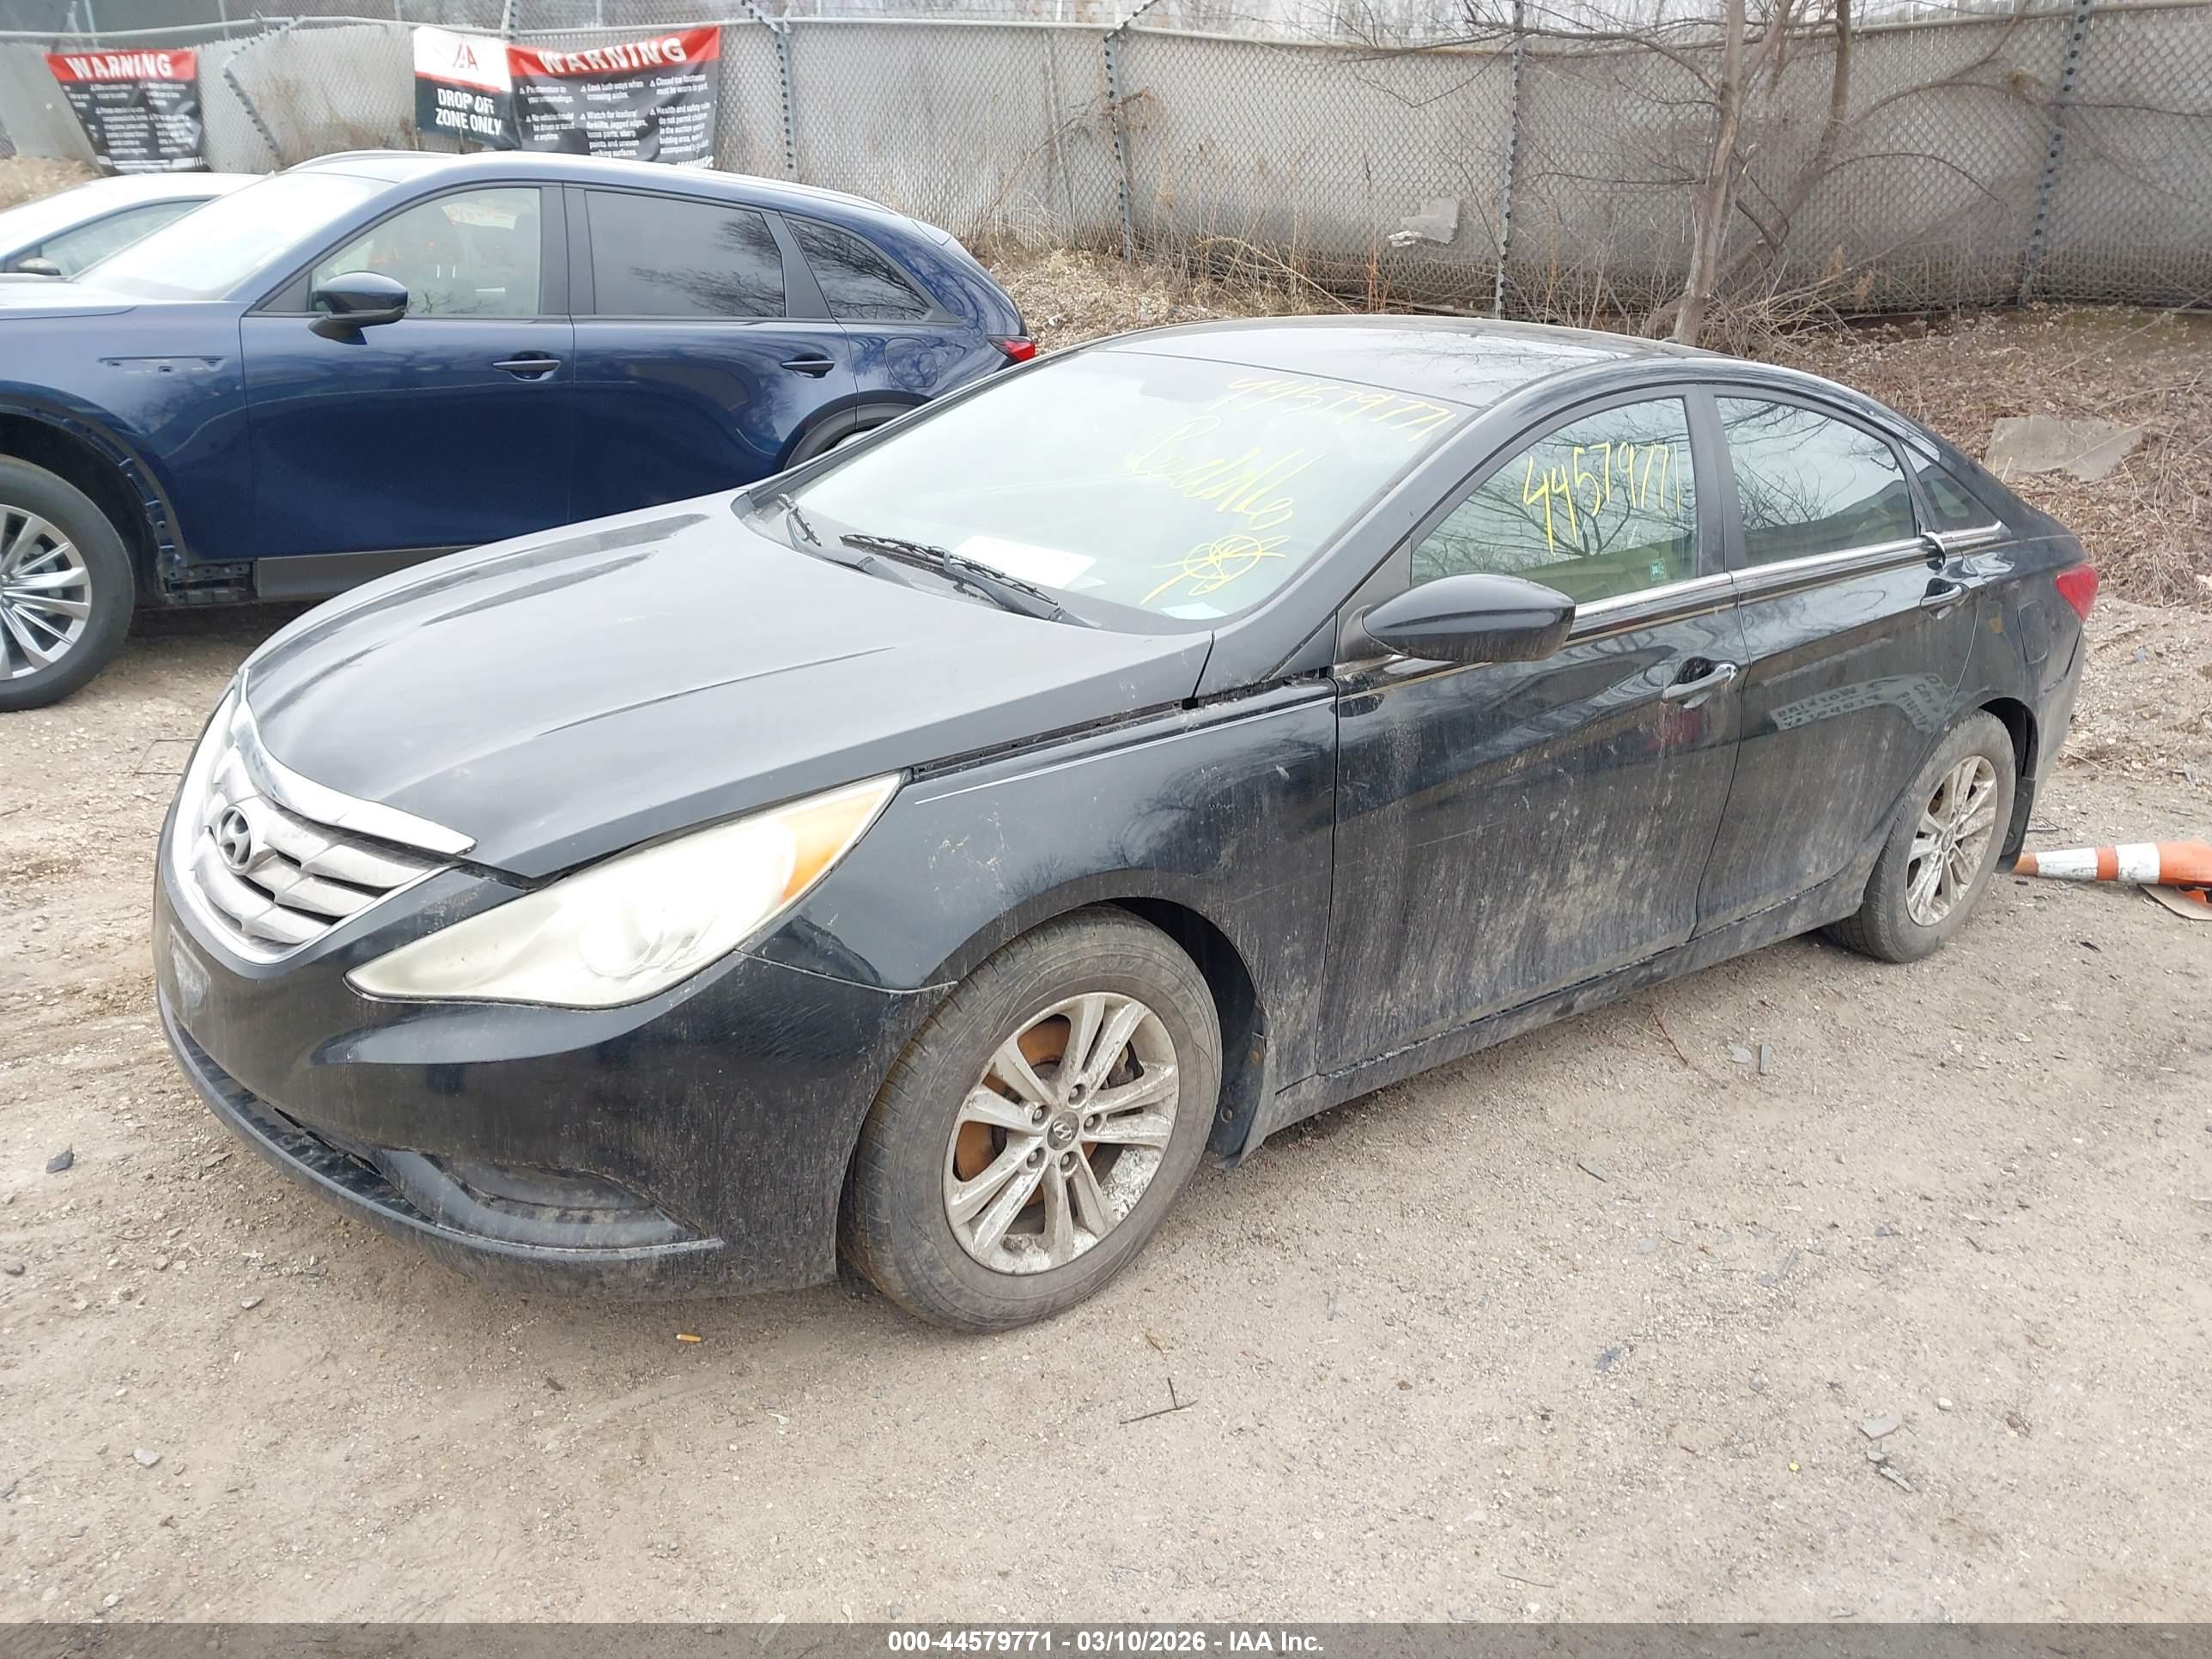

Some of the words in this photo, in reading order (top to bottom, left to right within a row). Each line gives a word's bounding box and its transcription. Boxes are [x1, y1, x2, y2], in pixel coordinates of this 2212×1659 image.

[539, 37, 687, 74] WARNING
[64, 53, 173, 79] WARNING
[655, 76, 674, 86] Closed
[587, 83, 601, 92] Look
[614, 82, 628, 91] ways
[437, 88, 473, 110] DROP
[474, 95, 495, 114] OFF
[587, 93, 611, 101] crossing
[656, 106, 676, 114] Health
[676, 105, 686, 113] and
[586, 111, 606, 119] Watch
[435, 108, 469, 130] ZONE
[470, 113, 502, 136] ONLY
[607, 139, 618, 148] and
[1522, 441, 1680, 557] 44579771
